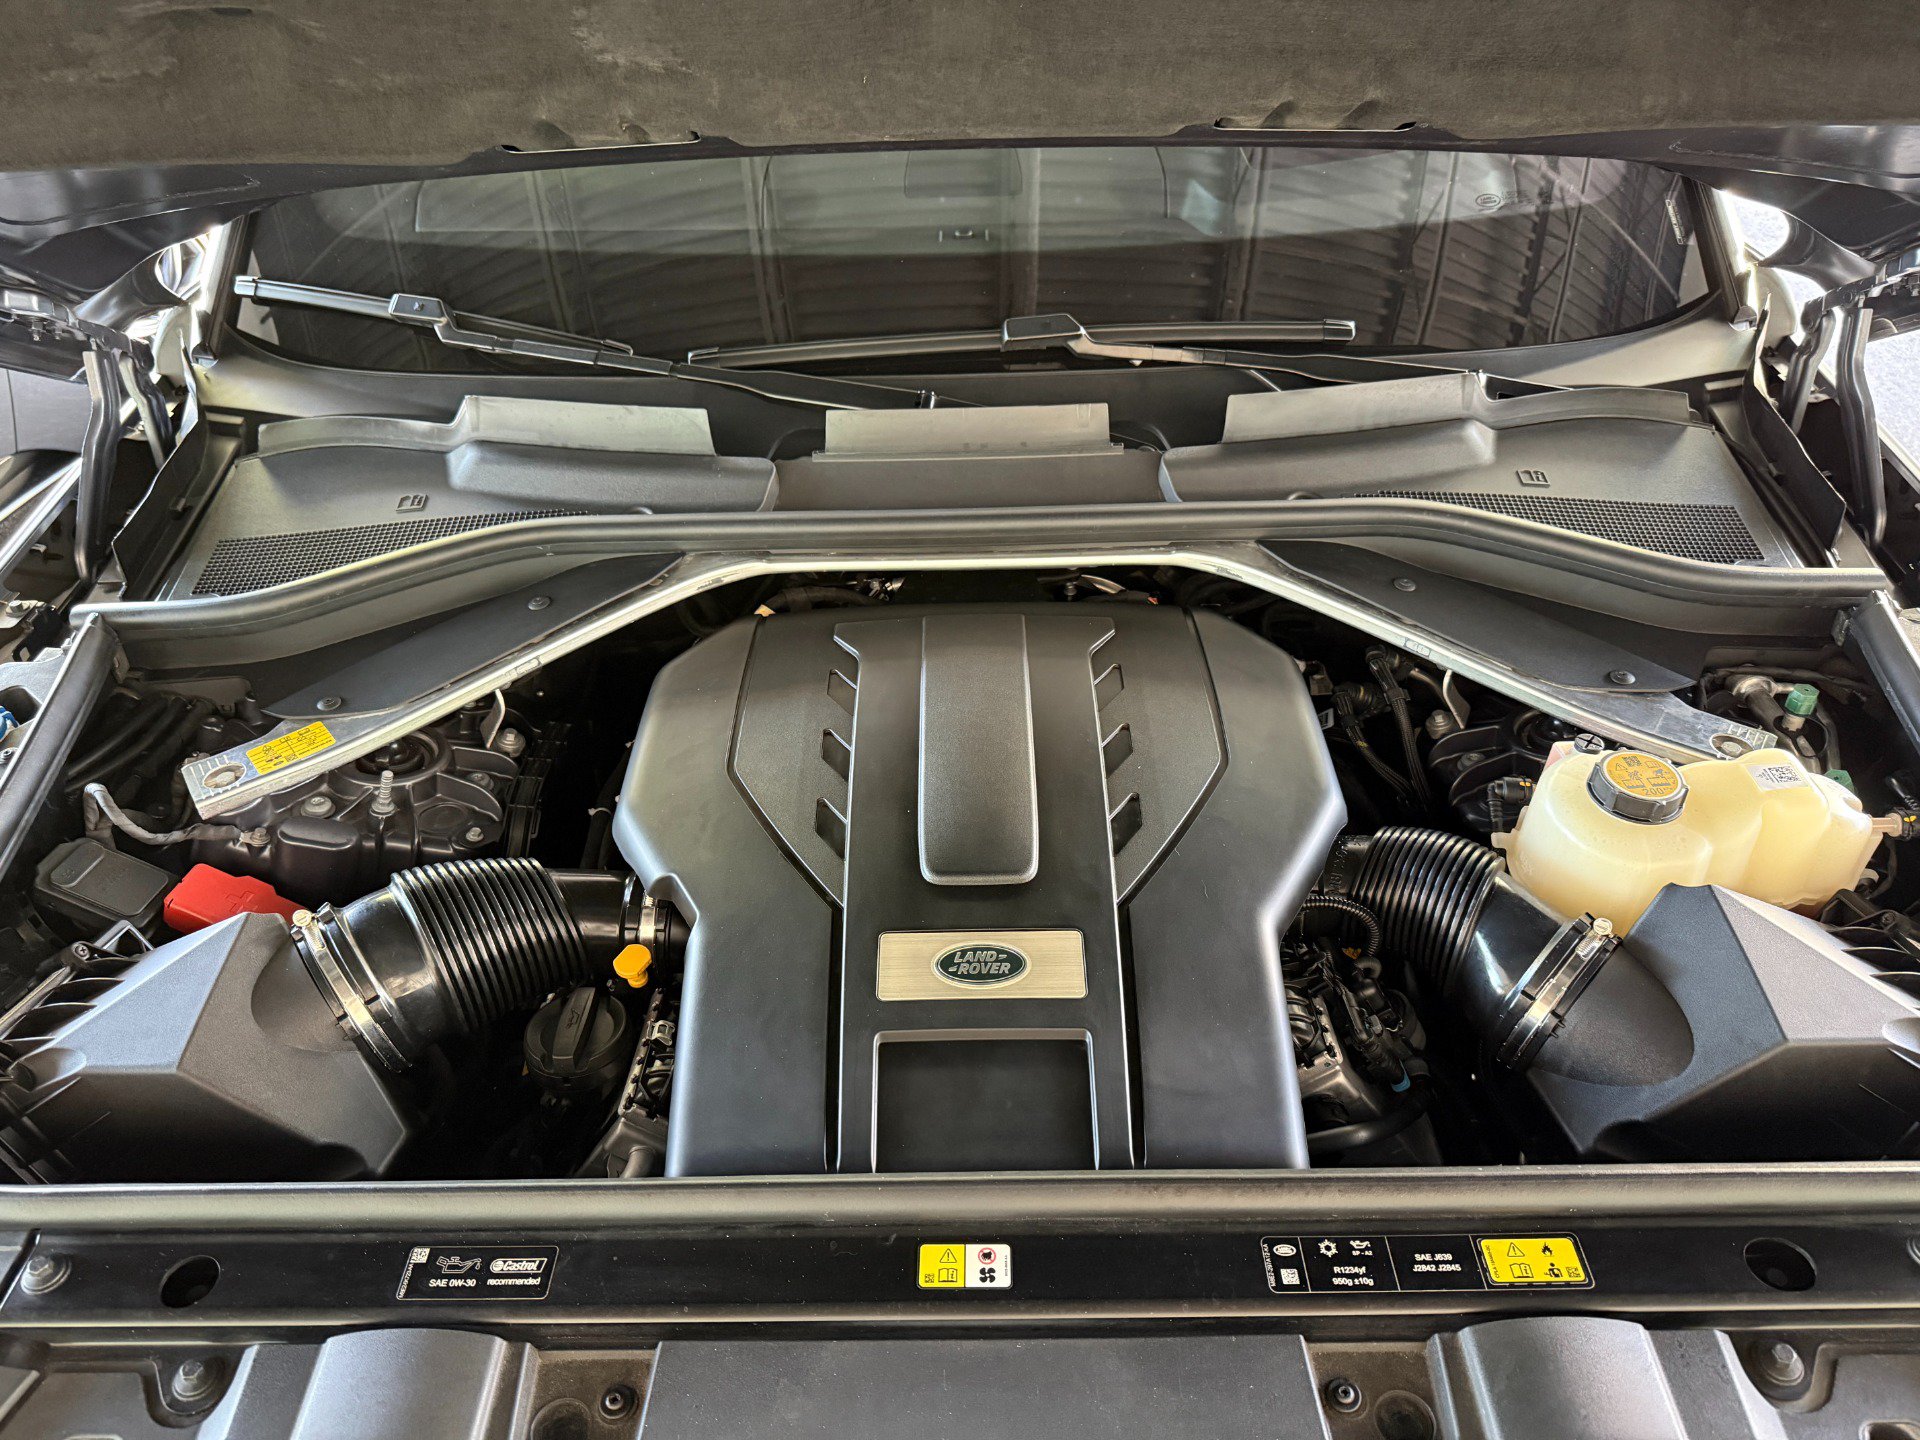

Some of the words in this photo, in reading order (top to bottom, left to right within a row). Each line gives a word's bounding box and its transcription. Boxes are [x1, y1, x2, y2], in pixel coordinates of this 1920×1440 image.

[1643, 787, 1664, 796] 200
[954, 951, 997, 962] LAND
[957, 963, 1011, 974] ROVER
[1414, 1253, 1433, 1261] SAE
[503, 1260, 539, 1271] Castrol
[1412, 1264, 1437, 1272] J2842
[1437, 1264, 1462, 1272] J2845
[1333, 1266, 1366, 1275] R1234yf
[429, 1279, 447, 1287] SAE
[448, 1279, 476, 1287] 0W-30
[487, 1277, 541, 1286] recommended
[1332, 1277, 1353, 1286] 950g
